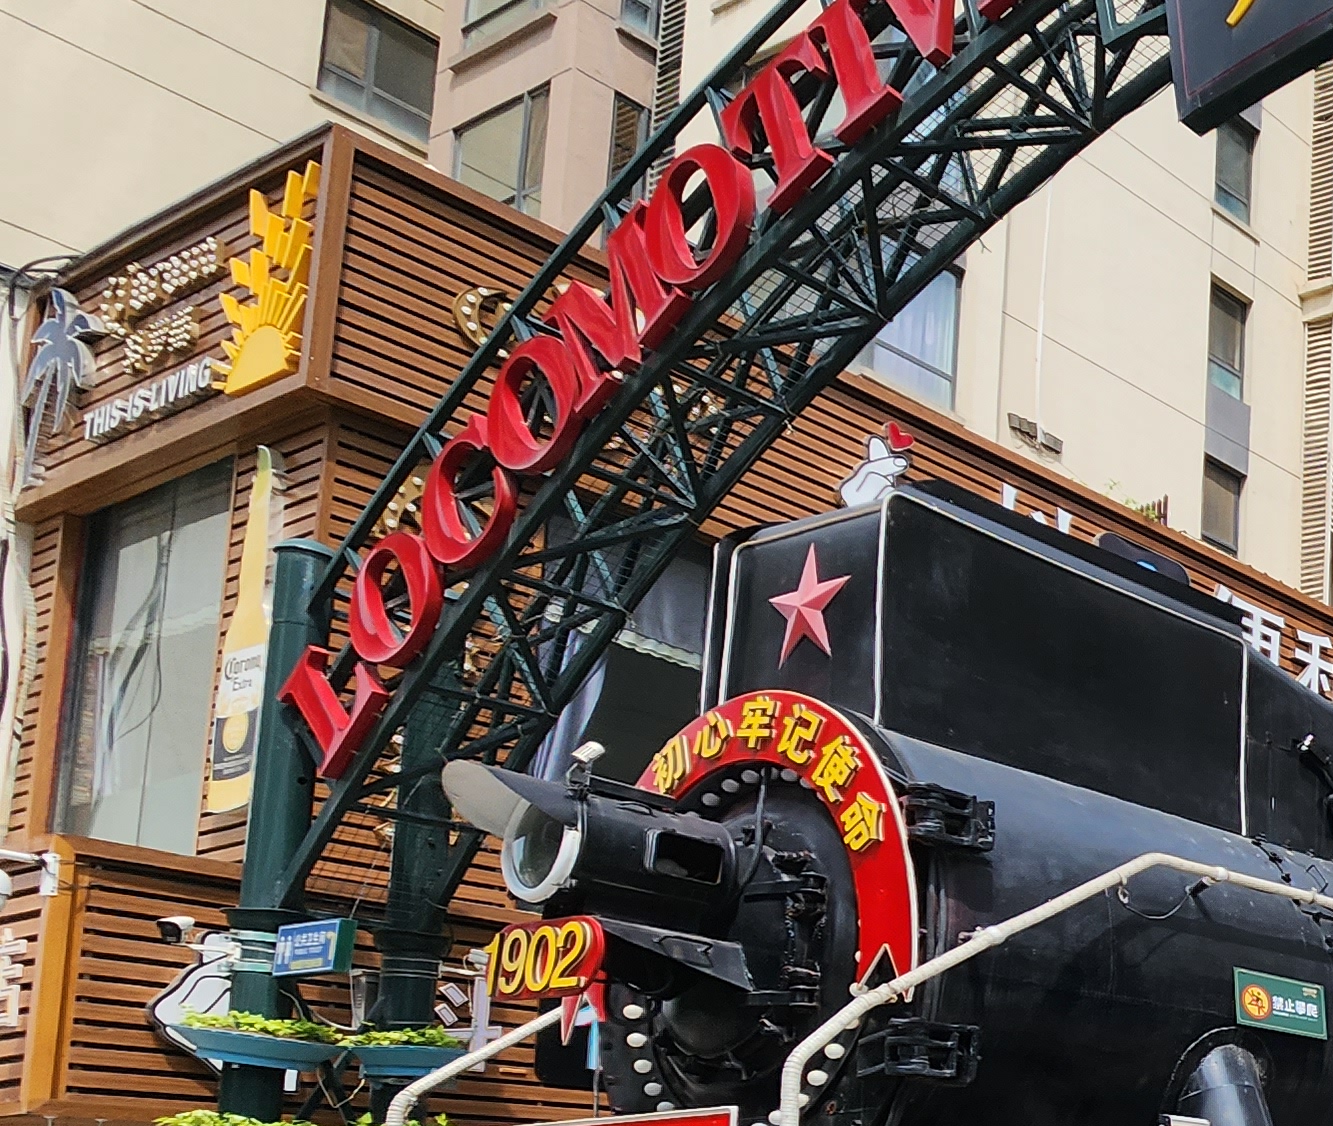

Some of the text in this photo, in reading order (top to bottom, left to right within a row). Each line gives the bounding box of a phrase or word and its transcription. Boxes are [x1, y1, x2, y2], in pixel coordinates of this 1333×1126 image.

[83, 359, 213, 441] THIS IS LIVING
[277, 0, 1010, 780] LOCOMOTI
[652, 695, 886, 852] 初心牢记使命
[484, 920, 586, 997] 1902
